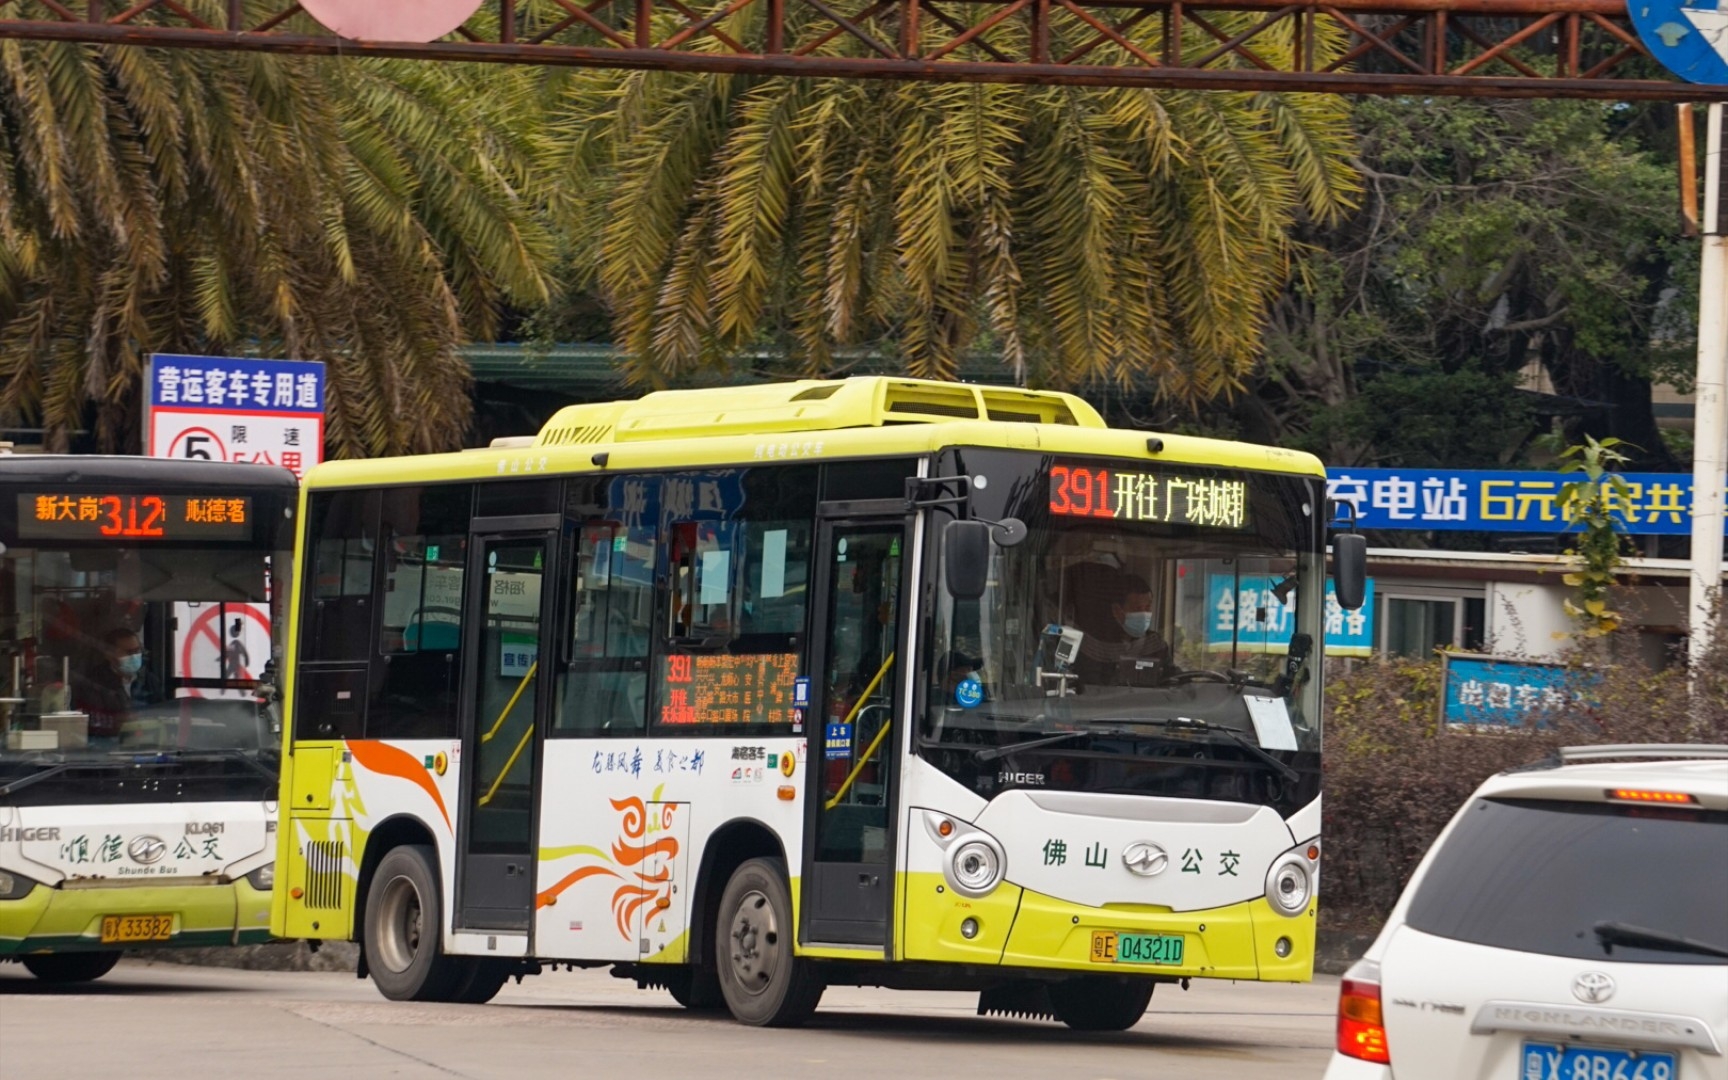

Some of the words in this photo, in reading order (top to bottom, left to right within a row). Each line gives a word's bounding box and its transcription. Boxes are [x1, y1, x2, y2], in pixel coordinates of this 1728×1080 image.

[158, 366, 318, 408] 营运客车专用道
[185, 436, 211, 460] 5
[1049, 465, 1113, 520] 391
[1326, 475, 1468, 521] 充电站
[101, 495, 163, 536] 312
[667, 655, 693, 683] 391
[998, 771, 1046, 785] HIGER
[0, 827, 61, 842] HIGER
[118, 867, 155, 875] Shunde
[159, 866, 178, 874] Bus
[1042, 839, 1108, 869] 佛山
[1181, 848, 1241, 877] 公交
[1495, 1007, 1681, 1036] HIGHLANDER
